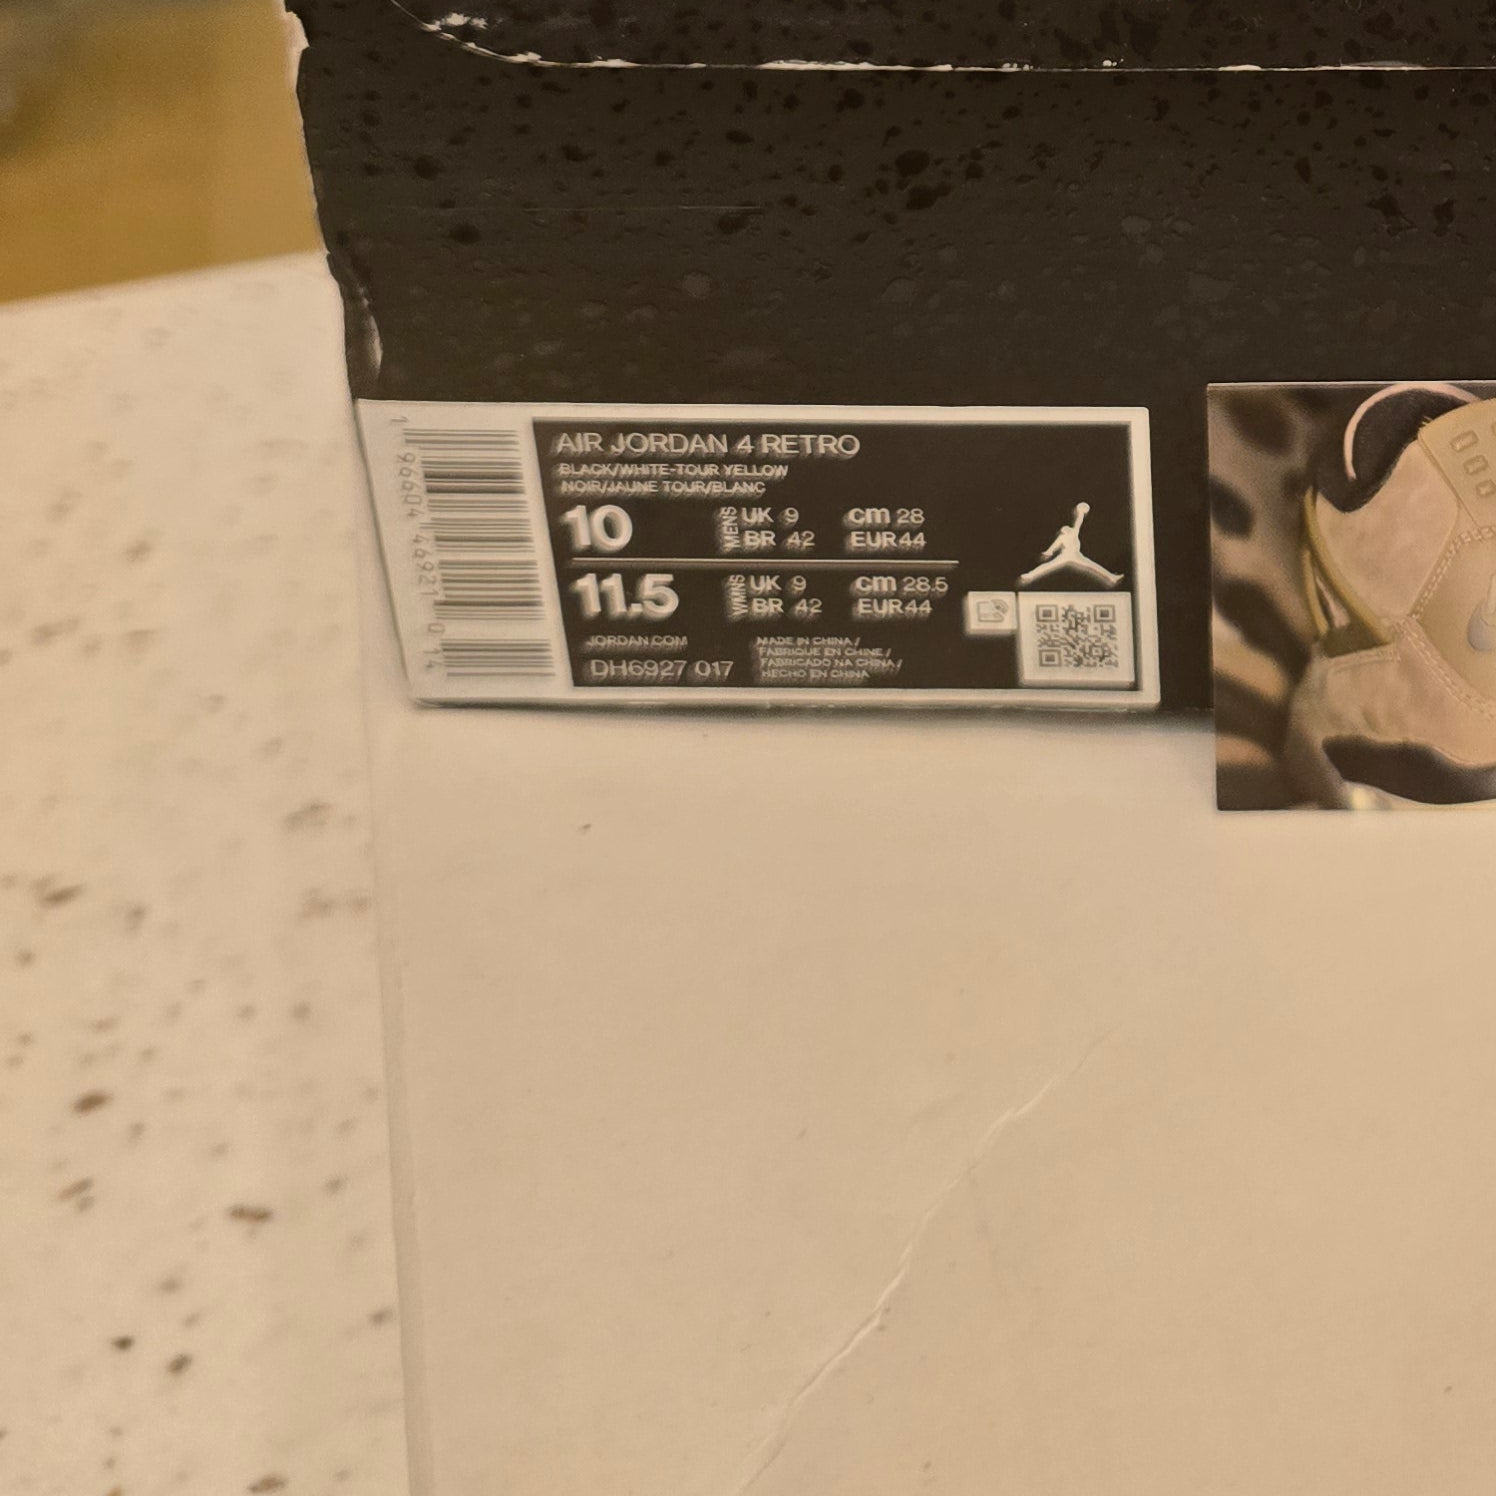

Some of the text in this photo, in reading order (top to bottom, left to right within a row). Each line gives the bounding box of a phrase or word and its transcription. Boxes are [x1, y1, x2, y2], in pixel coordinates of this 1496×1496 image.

[556, 432, 861, 456] AIR JORDAN 4 RETRO
[559, 462, 789, 478] BLACK/WHITE-TOUR YELLOW
[561, 480, 767, 495] NOIR/JAUNE TOUR/BLANC
[741, 506, 799, 523] UK 9
[849, 507, 925, 524] cm 28
[564, 504, 633, 549] 10
[720, 506, 741, 549] MENS
[743, 530, 816, 547] BR 42
[750, 575, 807, 591] UK 9
[855, 575, 949, 592] cm 28.5
[575, 573, 680, 618] 11.5
[752, 598, 823, 614] BR 42
[756, 636, 793, 646] MADE
[590, 659, 735, 678] DH6927 017
